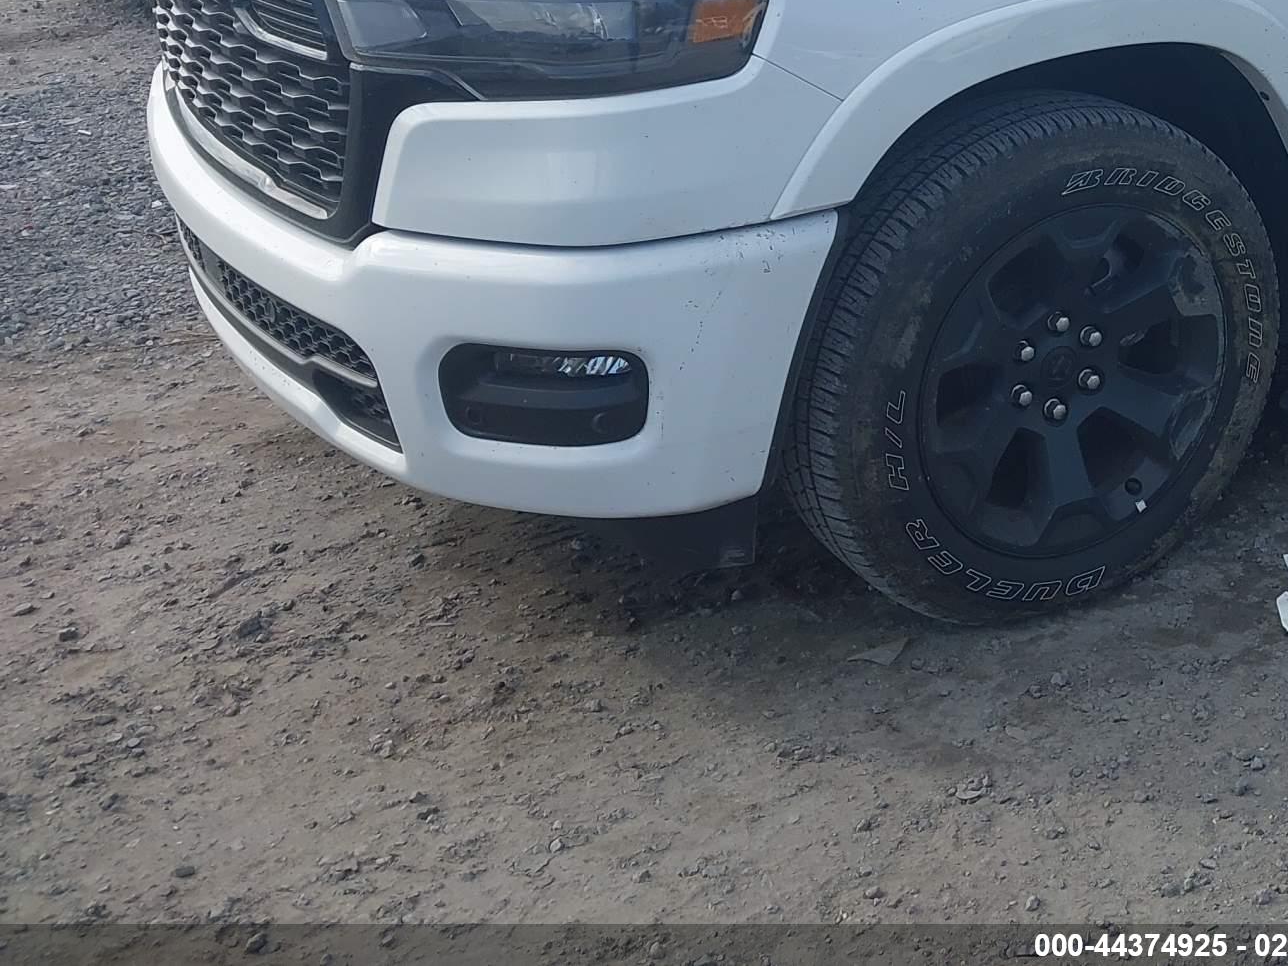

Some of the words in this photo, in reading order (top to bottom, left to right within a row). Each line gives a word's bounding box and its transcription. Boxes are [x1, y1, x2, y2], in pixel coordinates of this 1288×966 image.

[1062, 167, 1262, 384] BRIDGESTONE
[883, 390, 910, 491] H/L
[905, 518, 1106, 602] DUELER
